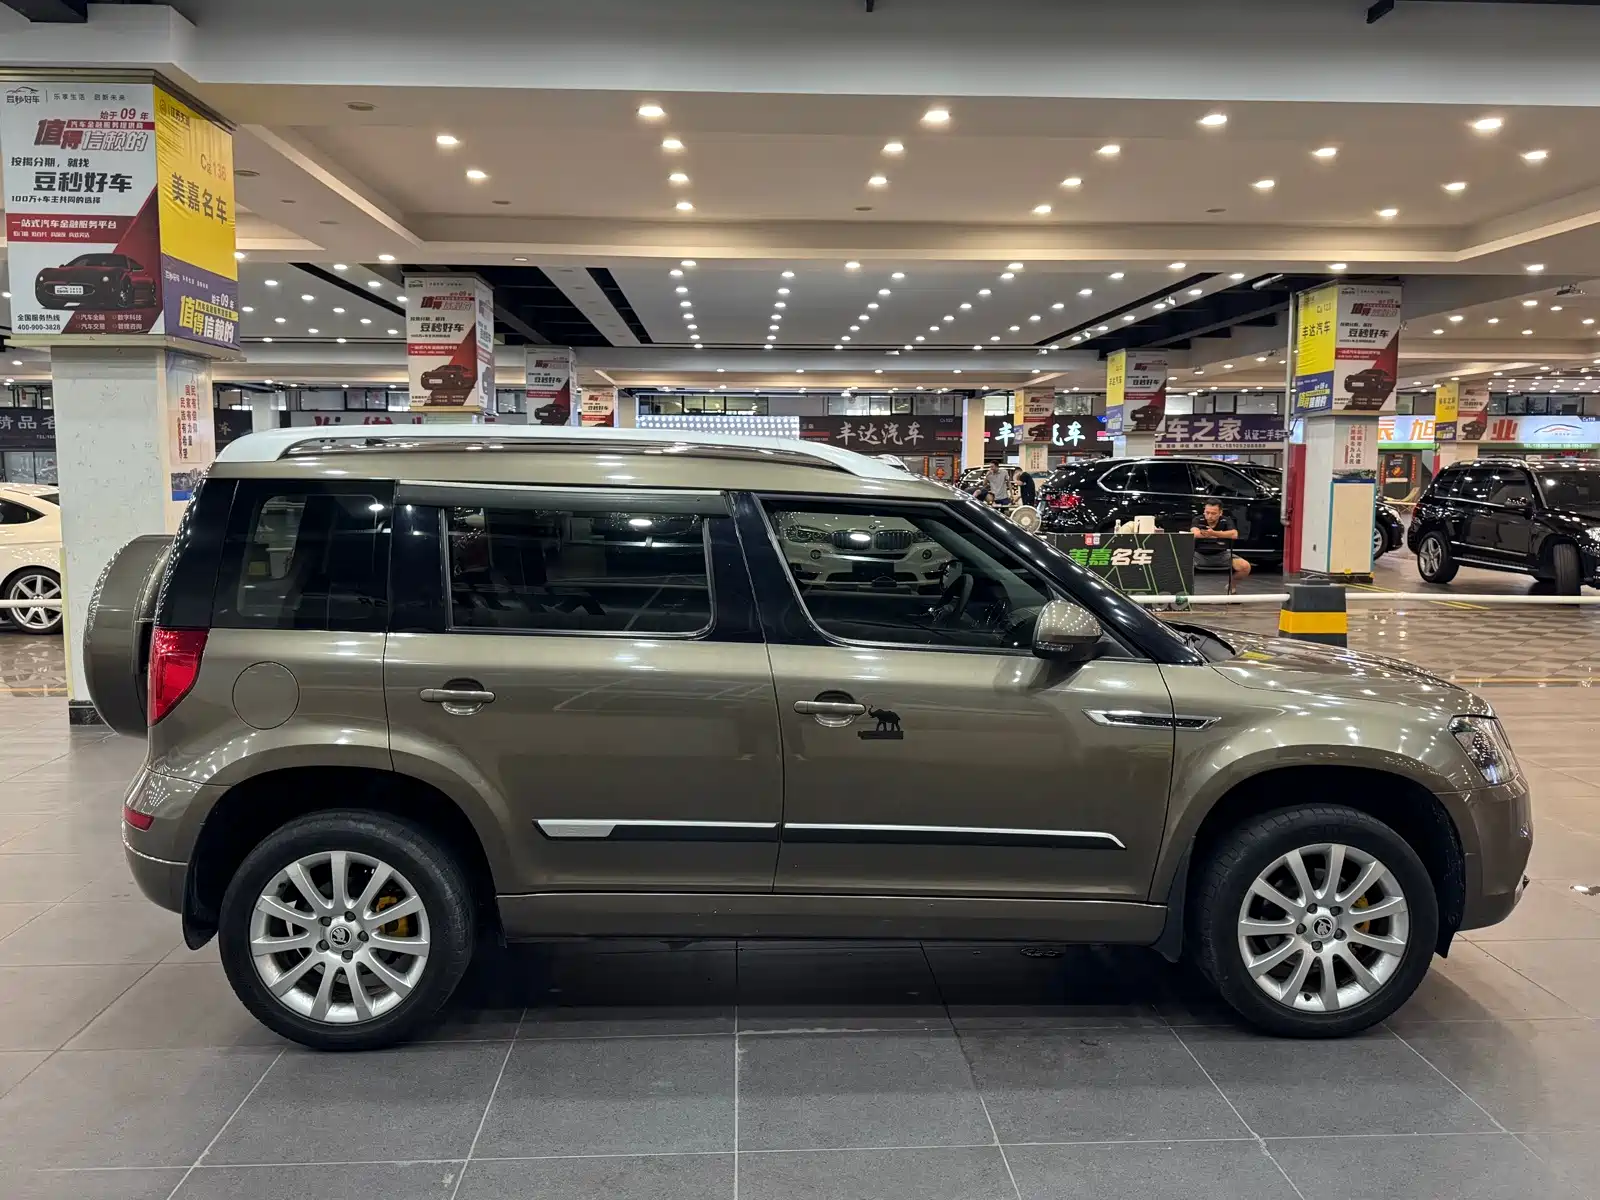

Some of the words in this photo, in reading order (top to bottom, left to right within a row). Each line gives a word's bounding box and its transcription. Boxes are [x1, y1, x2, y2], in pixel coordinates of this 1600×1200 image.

[34, 119, 148, 151] 值得信赖的
[33, 171, 133, 193] 豆秒好车
[11, 195, 101, 204] 100万+车主共同的选择
[172, 171, 228, 225] 美嘉名车
[12, 219, 117, 229] 一站式汽车金融服务平台
[17, 313, 61, 322] 全国服务热线
[420, 322, 465, 333] 豆秒好车
[1302, 320, 1331, 338] 丰达汽车
[1348, 328, 1389, 338] 豆秒好车
[835, 421, 925, 447] 丰达汽车
[1069, 548, 1154, 566] 美嘉名车
